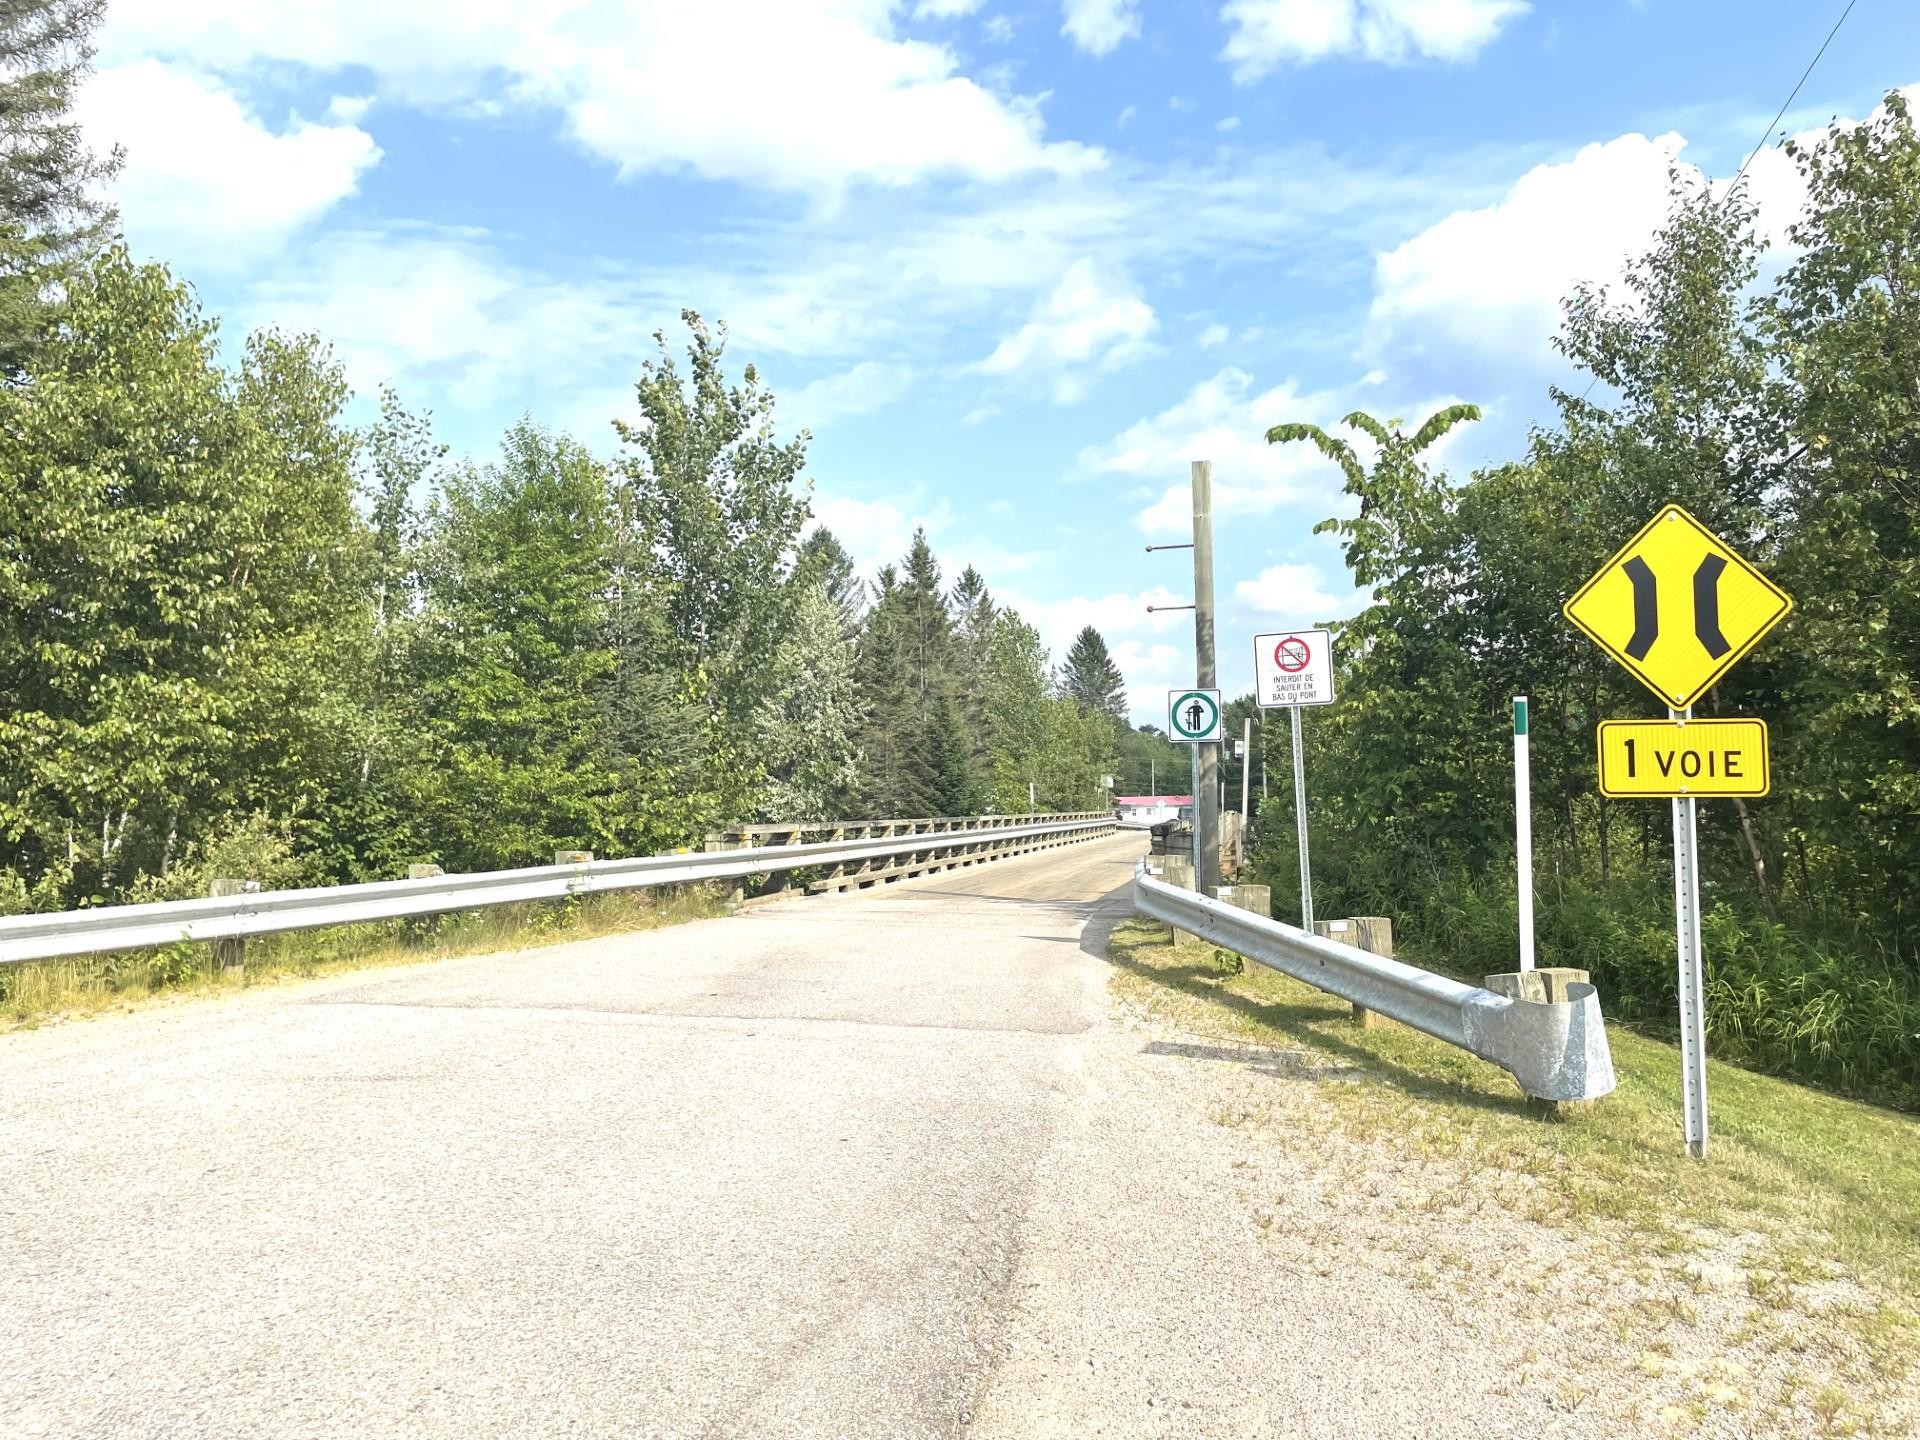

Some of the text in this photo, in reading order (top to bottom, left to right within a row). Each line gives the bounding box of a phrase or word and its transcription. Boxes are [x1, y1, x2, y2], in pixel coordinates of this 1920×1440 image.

[1273, 674, 1314, 683] INTERDIT DE
[1276, 683, 1301, 691] SAUTER
[1272, 691, 1316, 701] BAS DU PONT
[1624, 738, 1743, 778] 1 VOIE
